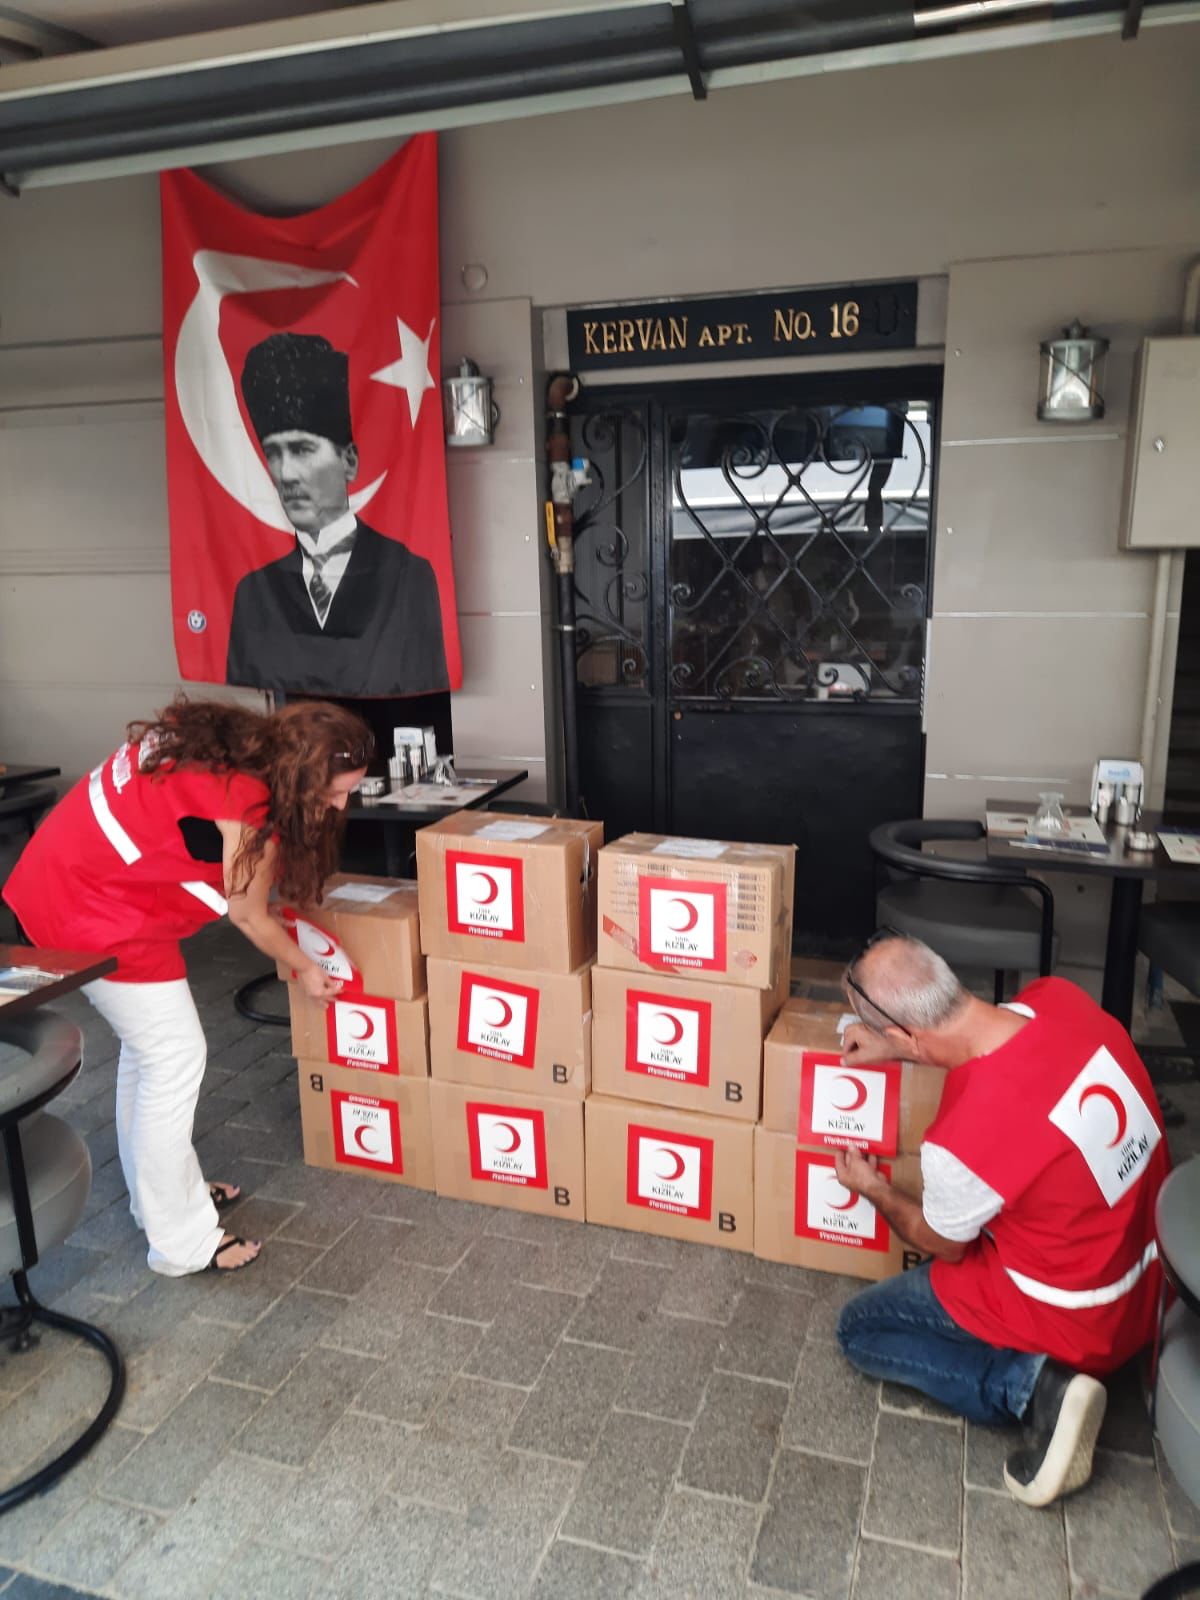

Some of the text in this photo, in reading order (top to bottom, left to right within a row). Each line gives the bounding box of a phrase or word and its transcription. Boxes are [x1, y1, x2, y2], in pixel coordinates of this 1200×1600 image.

[583, 316, 689, 355] KERVAN
[698, 323, 753, 347] APT.
[829, 301, 860, 339] 16
[552, 1063, 568, 1084] B
[725, 1080, 743, 1103] B
[1116, 1133, 1149, 1181] KIZILAY
[554, 1186, 571, 1206] B
[718, 1211, 737, 1233] B
